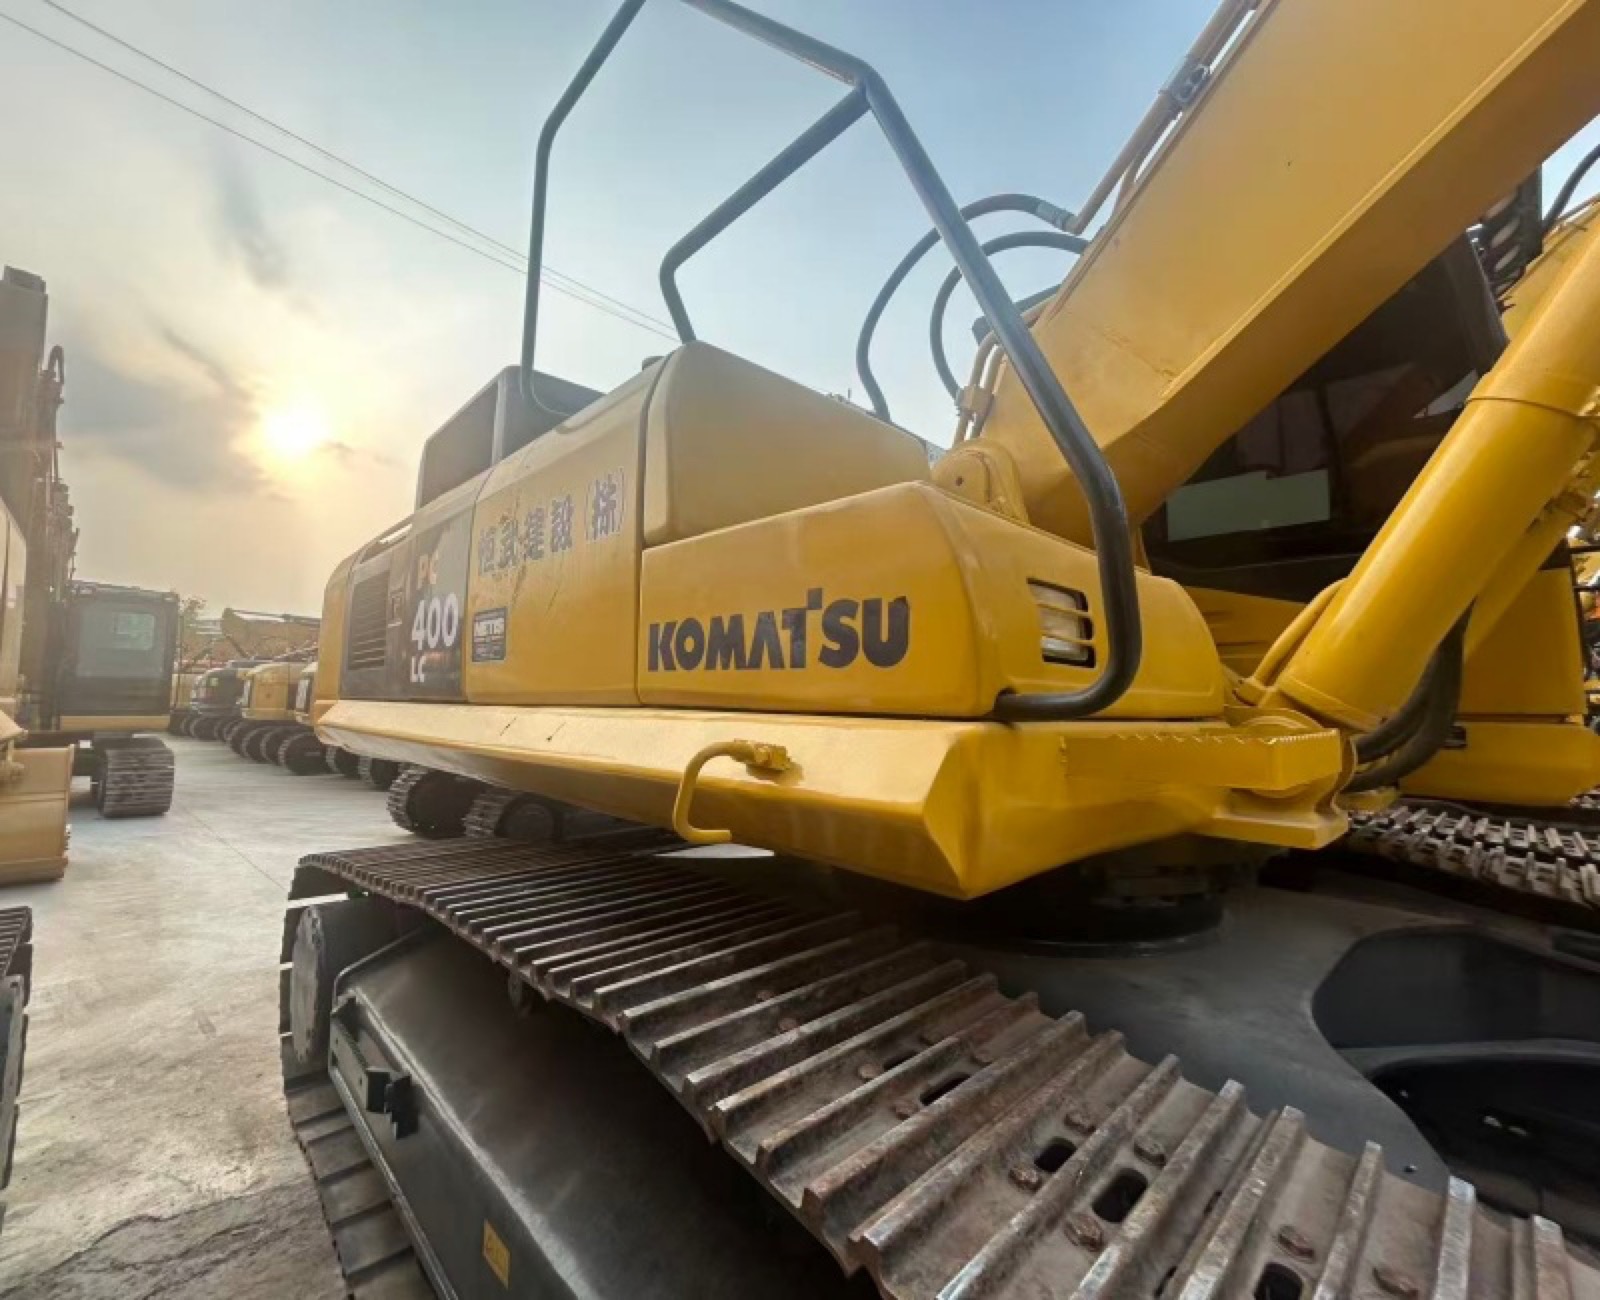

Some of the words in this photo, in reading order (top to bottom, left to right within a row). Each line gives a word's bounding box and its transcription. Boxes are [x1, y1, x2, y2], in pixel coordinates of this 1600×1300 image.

[417, 548, 440, 590] PC
[411, 592, 459, 651] 400
[648, 587, 910, 672] KOMATSU
[409, 655, 427, 683] LC
